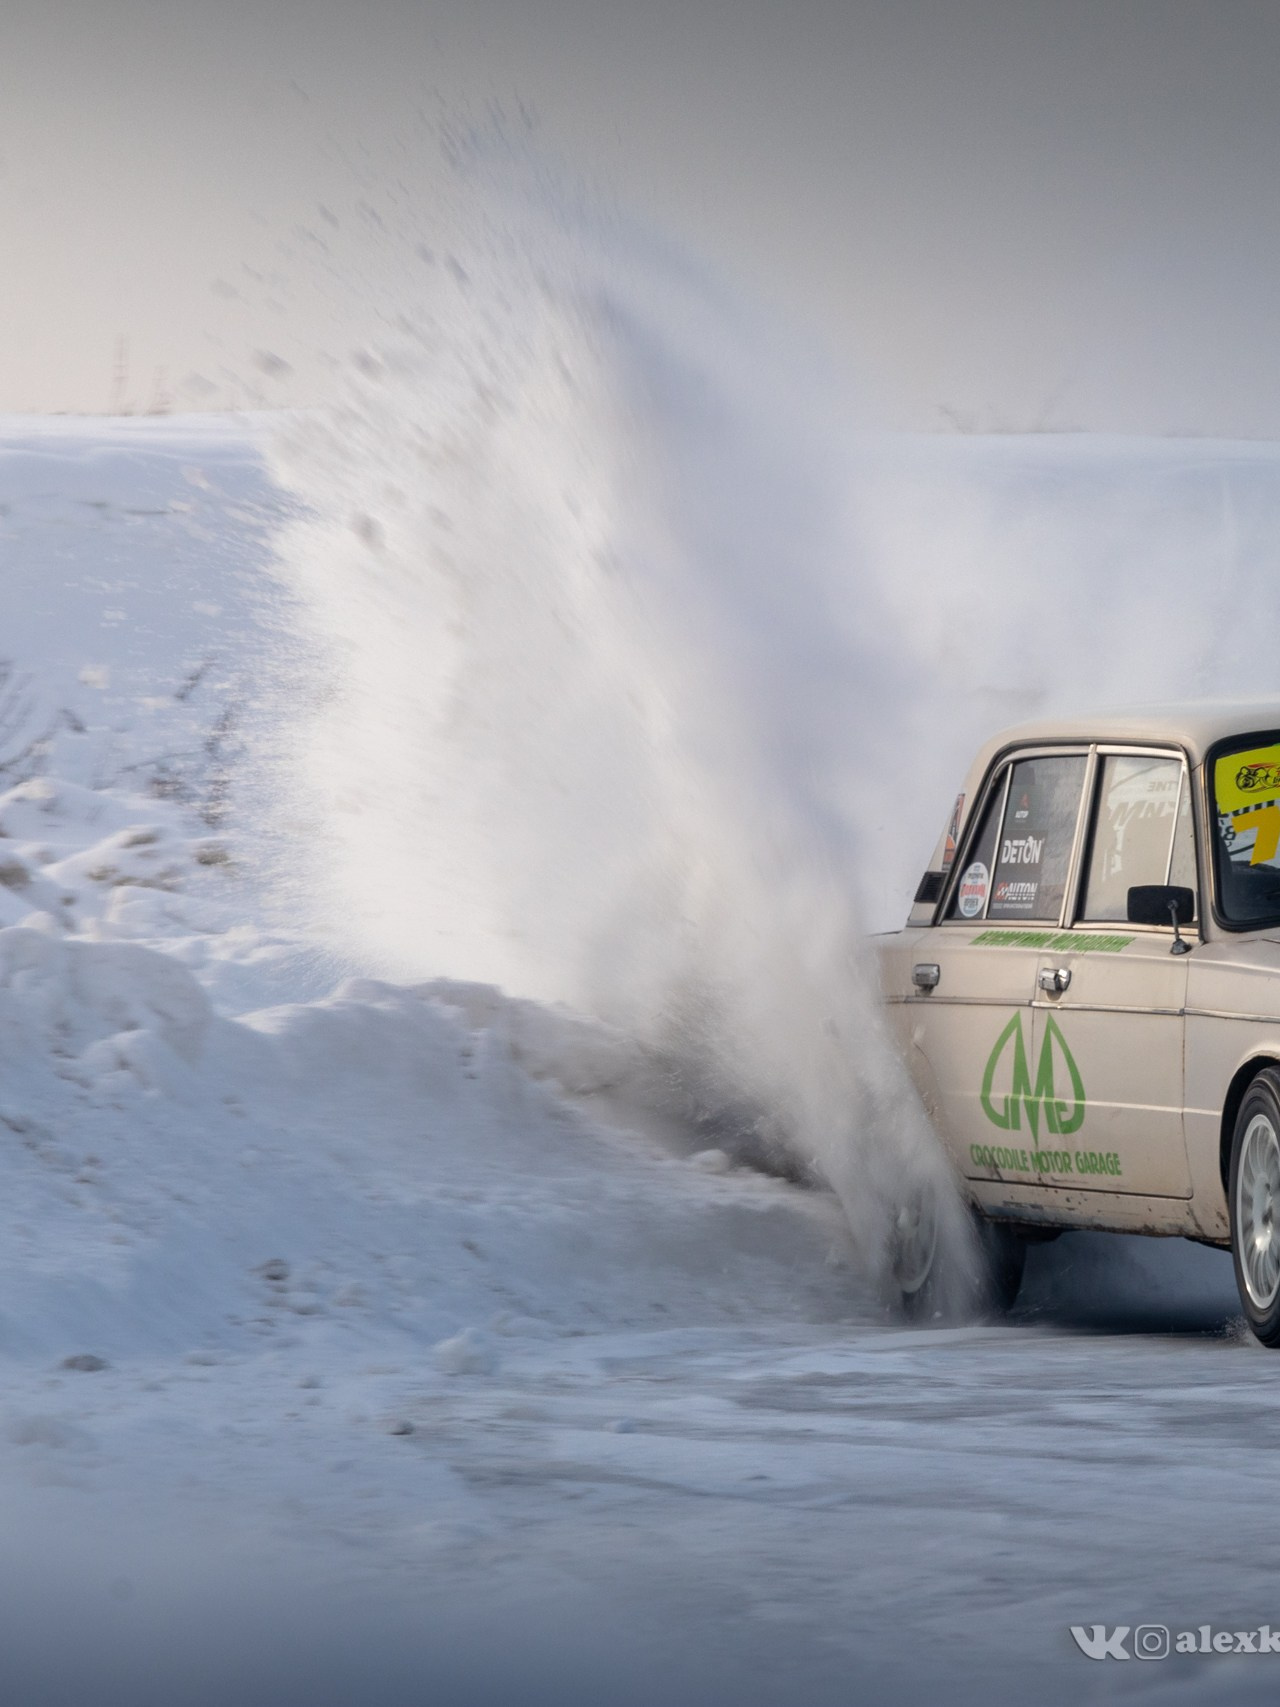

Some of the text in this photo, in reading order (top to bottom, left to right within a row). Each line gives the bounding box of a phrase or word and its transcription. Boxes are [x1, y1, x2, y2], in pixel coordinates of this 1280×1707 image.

[1001, 836, 1042, 864] DETON
[969, 1143, 1122, 1176] CROCODILE MOTOR GARAGE
